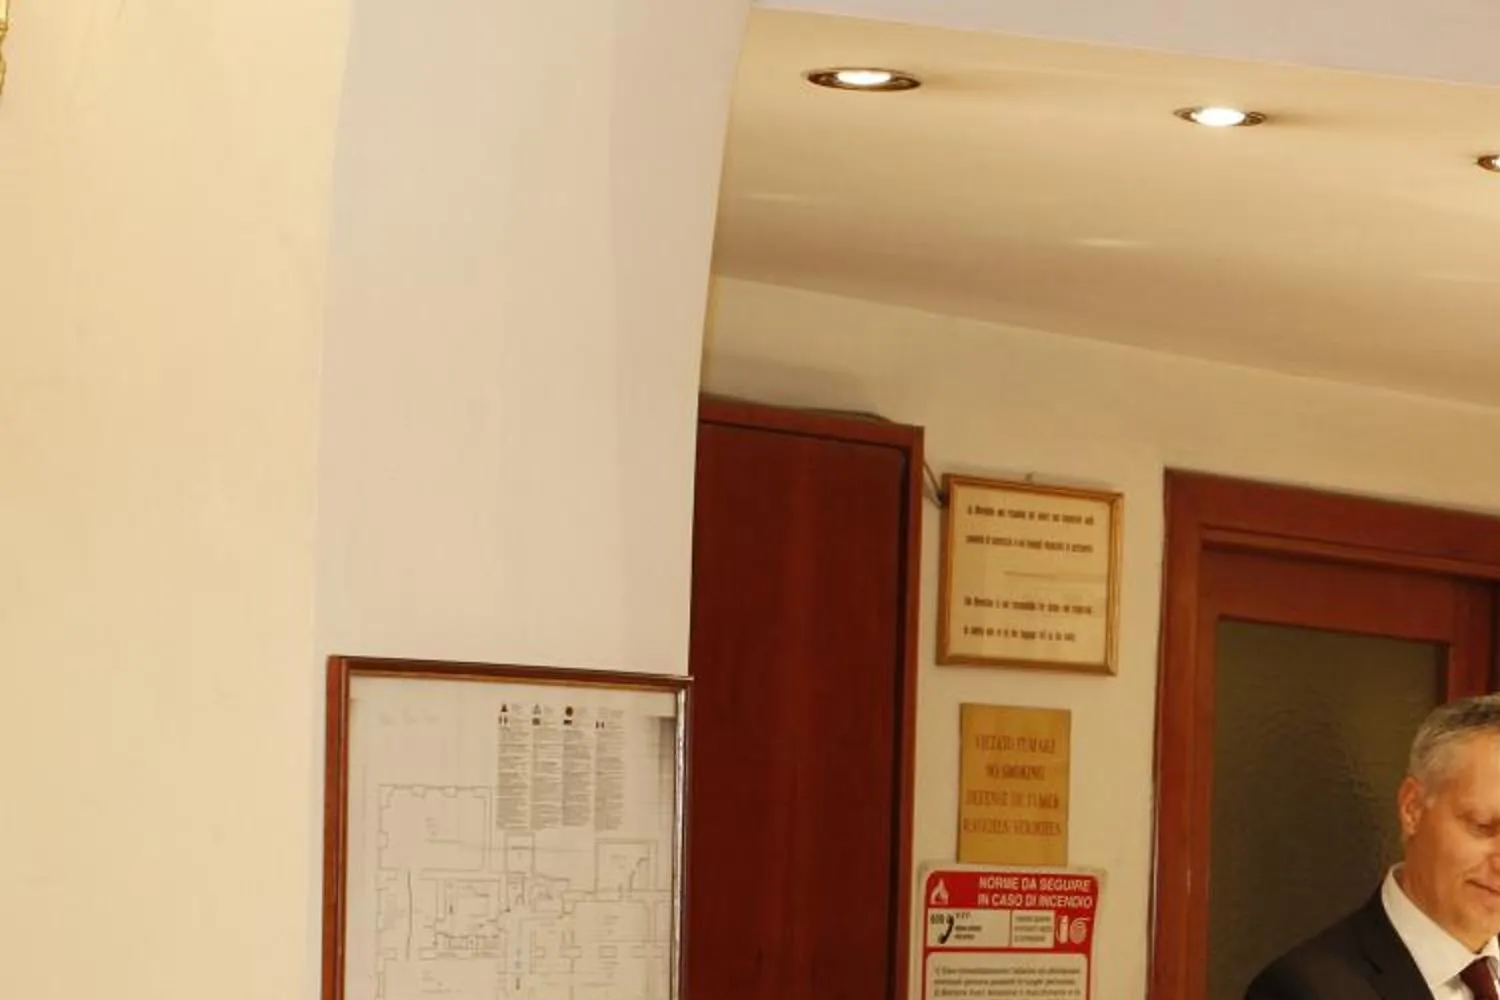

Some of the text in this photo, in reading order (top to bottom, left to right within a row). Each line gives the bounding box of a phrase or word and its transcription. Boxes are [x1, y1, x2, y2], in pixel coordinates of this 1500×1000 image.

[978, 876, 1091, 893] NORME DA SEGUIRE
[977, 893, 1093, 909] IN CASO DI INCENDIO
